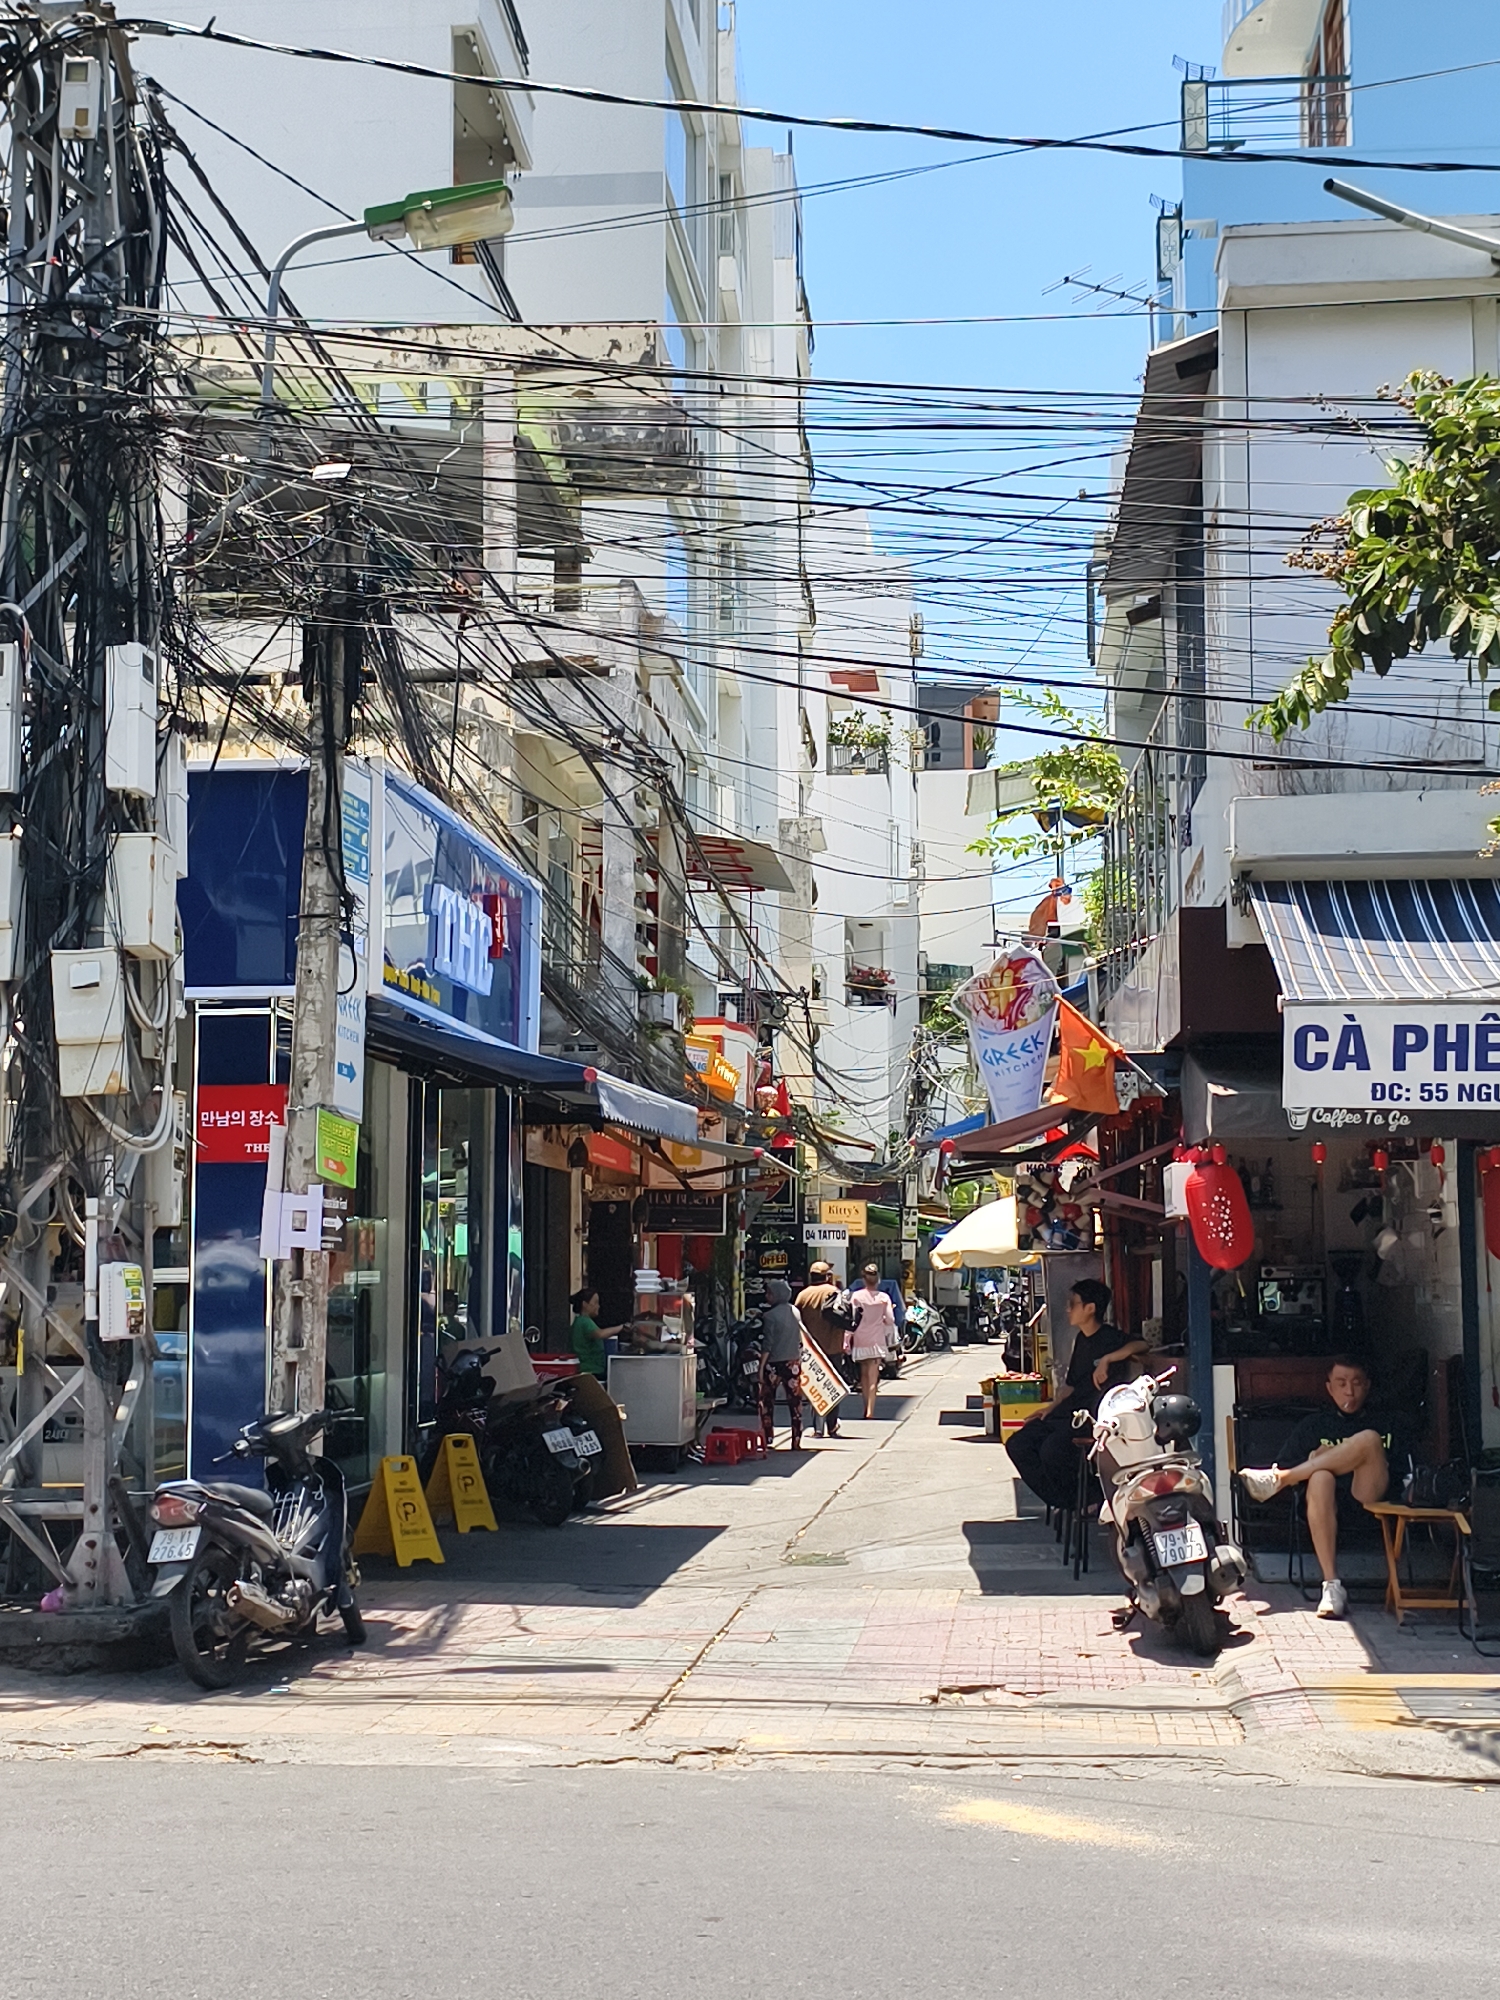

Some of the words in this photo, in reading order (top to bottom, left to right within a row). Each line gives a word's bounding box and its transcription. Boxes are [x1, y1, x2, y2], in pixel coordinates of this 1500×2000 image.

[982, 1030, 1044, 1067] GREEK
[1293, 1013, 1371, 1072] CÀ
[1392, 1012, 1500, 1072] PHÊ
[994, 1053, 1043, 1078] KITCHEN
[1371, 1082, 1411, 1102] ĐC:
[1419, 1083, 1449, 1102] 55
[201, 1110, 245, 1127] 만남의
[249, 1110, 280, 1127] 장소
[1312, 1107, 1363, 1128] Coffee
[1364, 1109, 1386, 1126] To
[1388, 1110, 1411, 1132] Go
[828, 1204, 860, 1218] Kitty's
[817, 1228, 847, 1240] TATTOO
